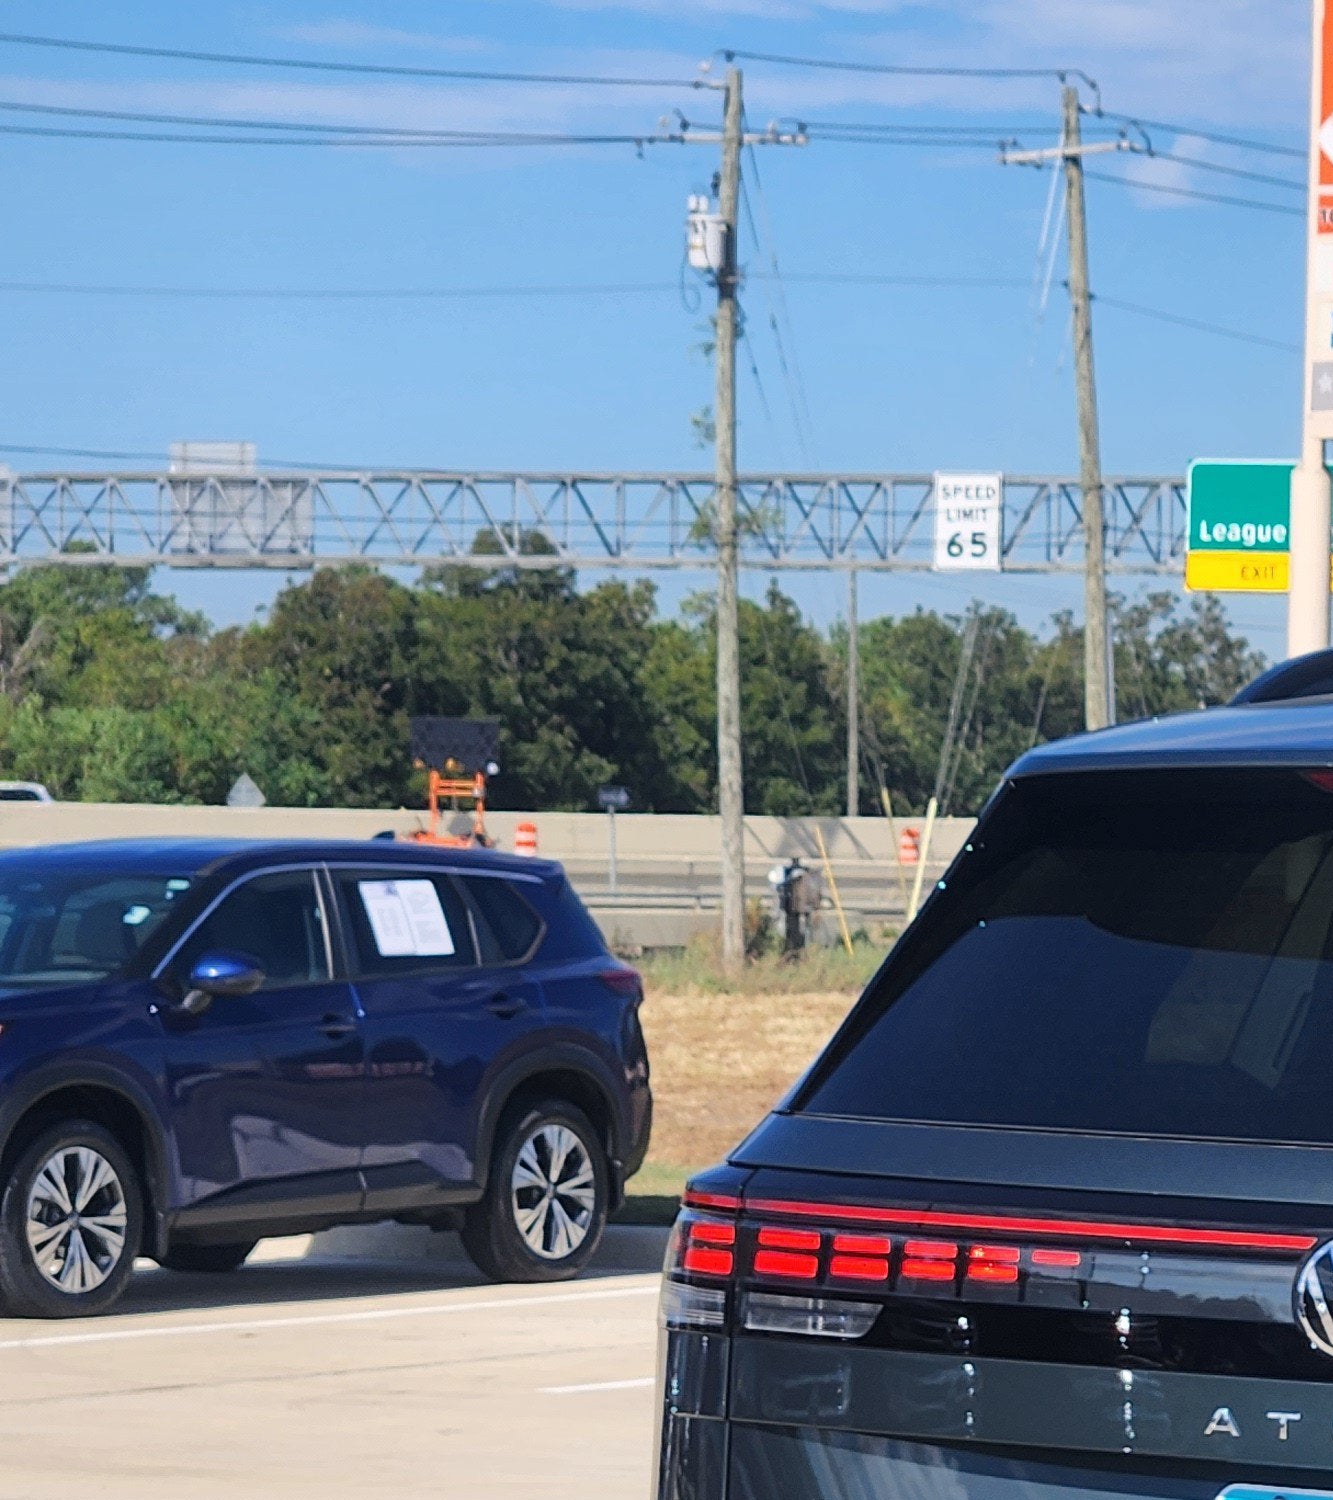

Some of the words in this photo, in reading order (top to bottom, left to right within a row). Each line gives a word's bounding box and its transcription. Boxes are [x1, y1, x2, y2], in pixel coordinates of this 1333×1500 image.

[942, 484, 996, 500] SPEED
[946, 508, 988, 521] LIMIT
[1200, 519, 1287, 547] League
[946, 532, 987, 557] 65
[1241, 565, 1276, 580] EXIT
